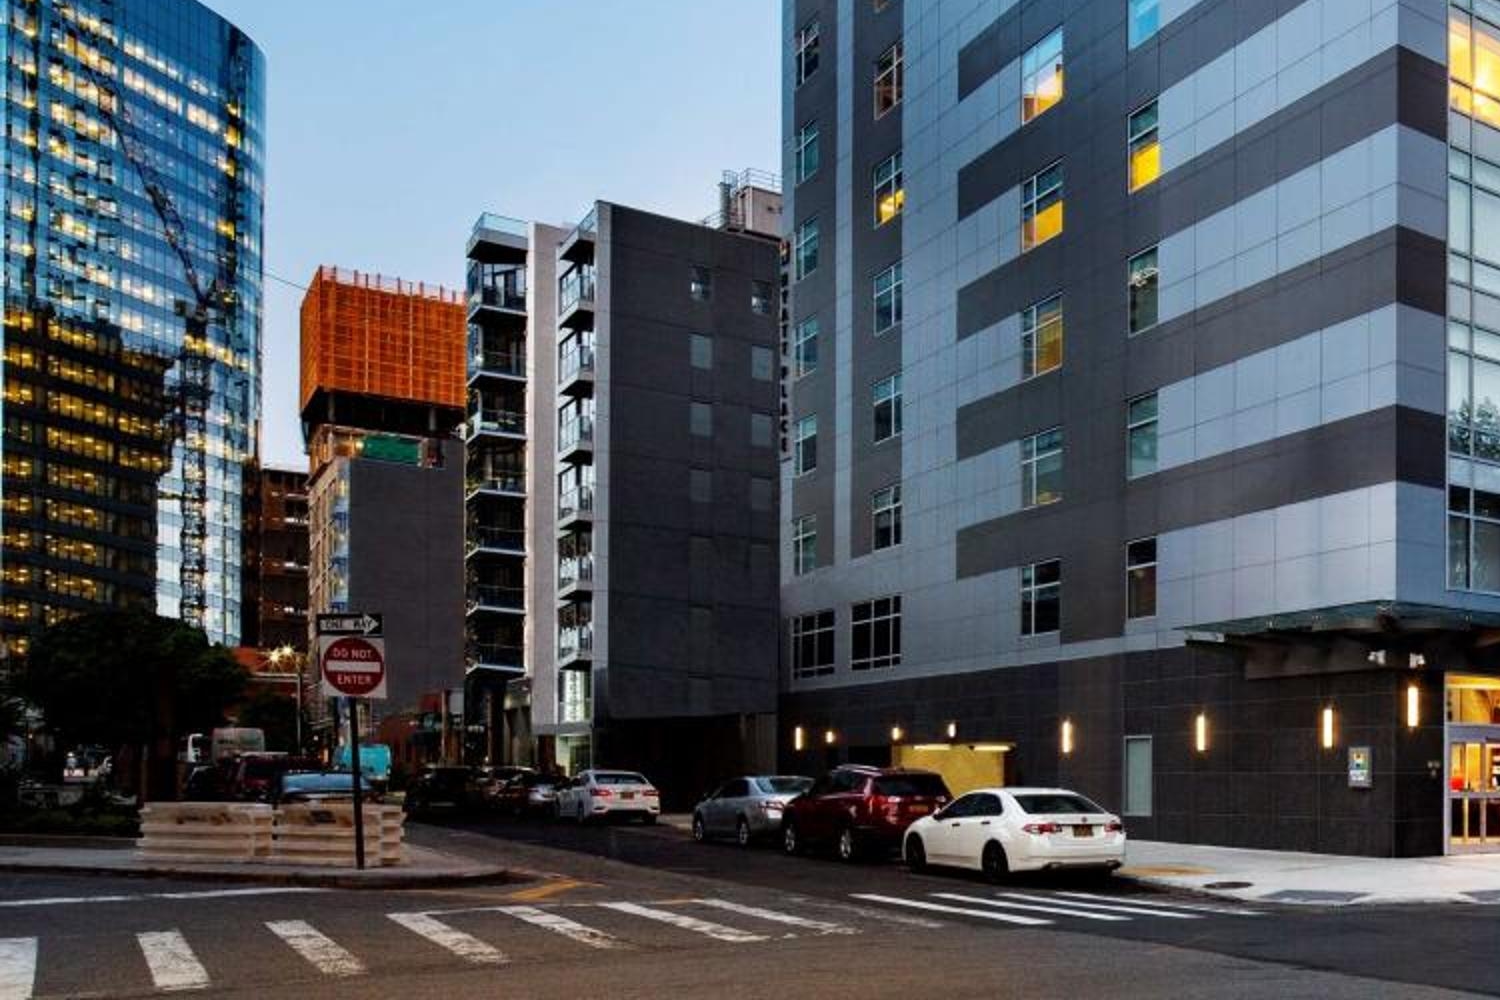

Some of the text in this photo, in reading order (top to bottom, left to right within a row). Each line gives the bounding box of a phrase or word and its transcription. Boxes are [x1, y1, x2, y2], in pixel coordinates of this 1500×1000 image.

[325, 618, 373, 629] ONE WAY
[333, 647, 372, 659] DO NOT
[337, 673, 372, 685] ENTER
